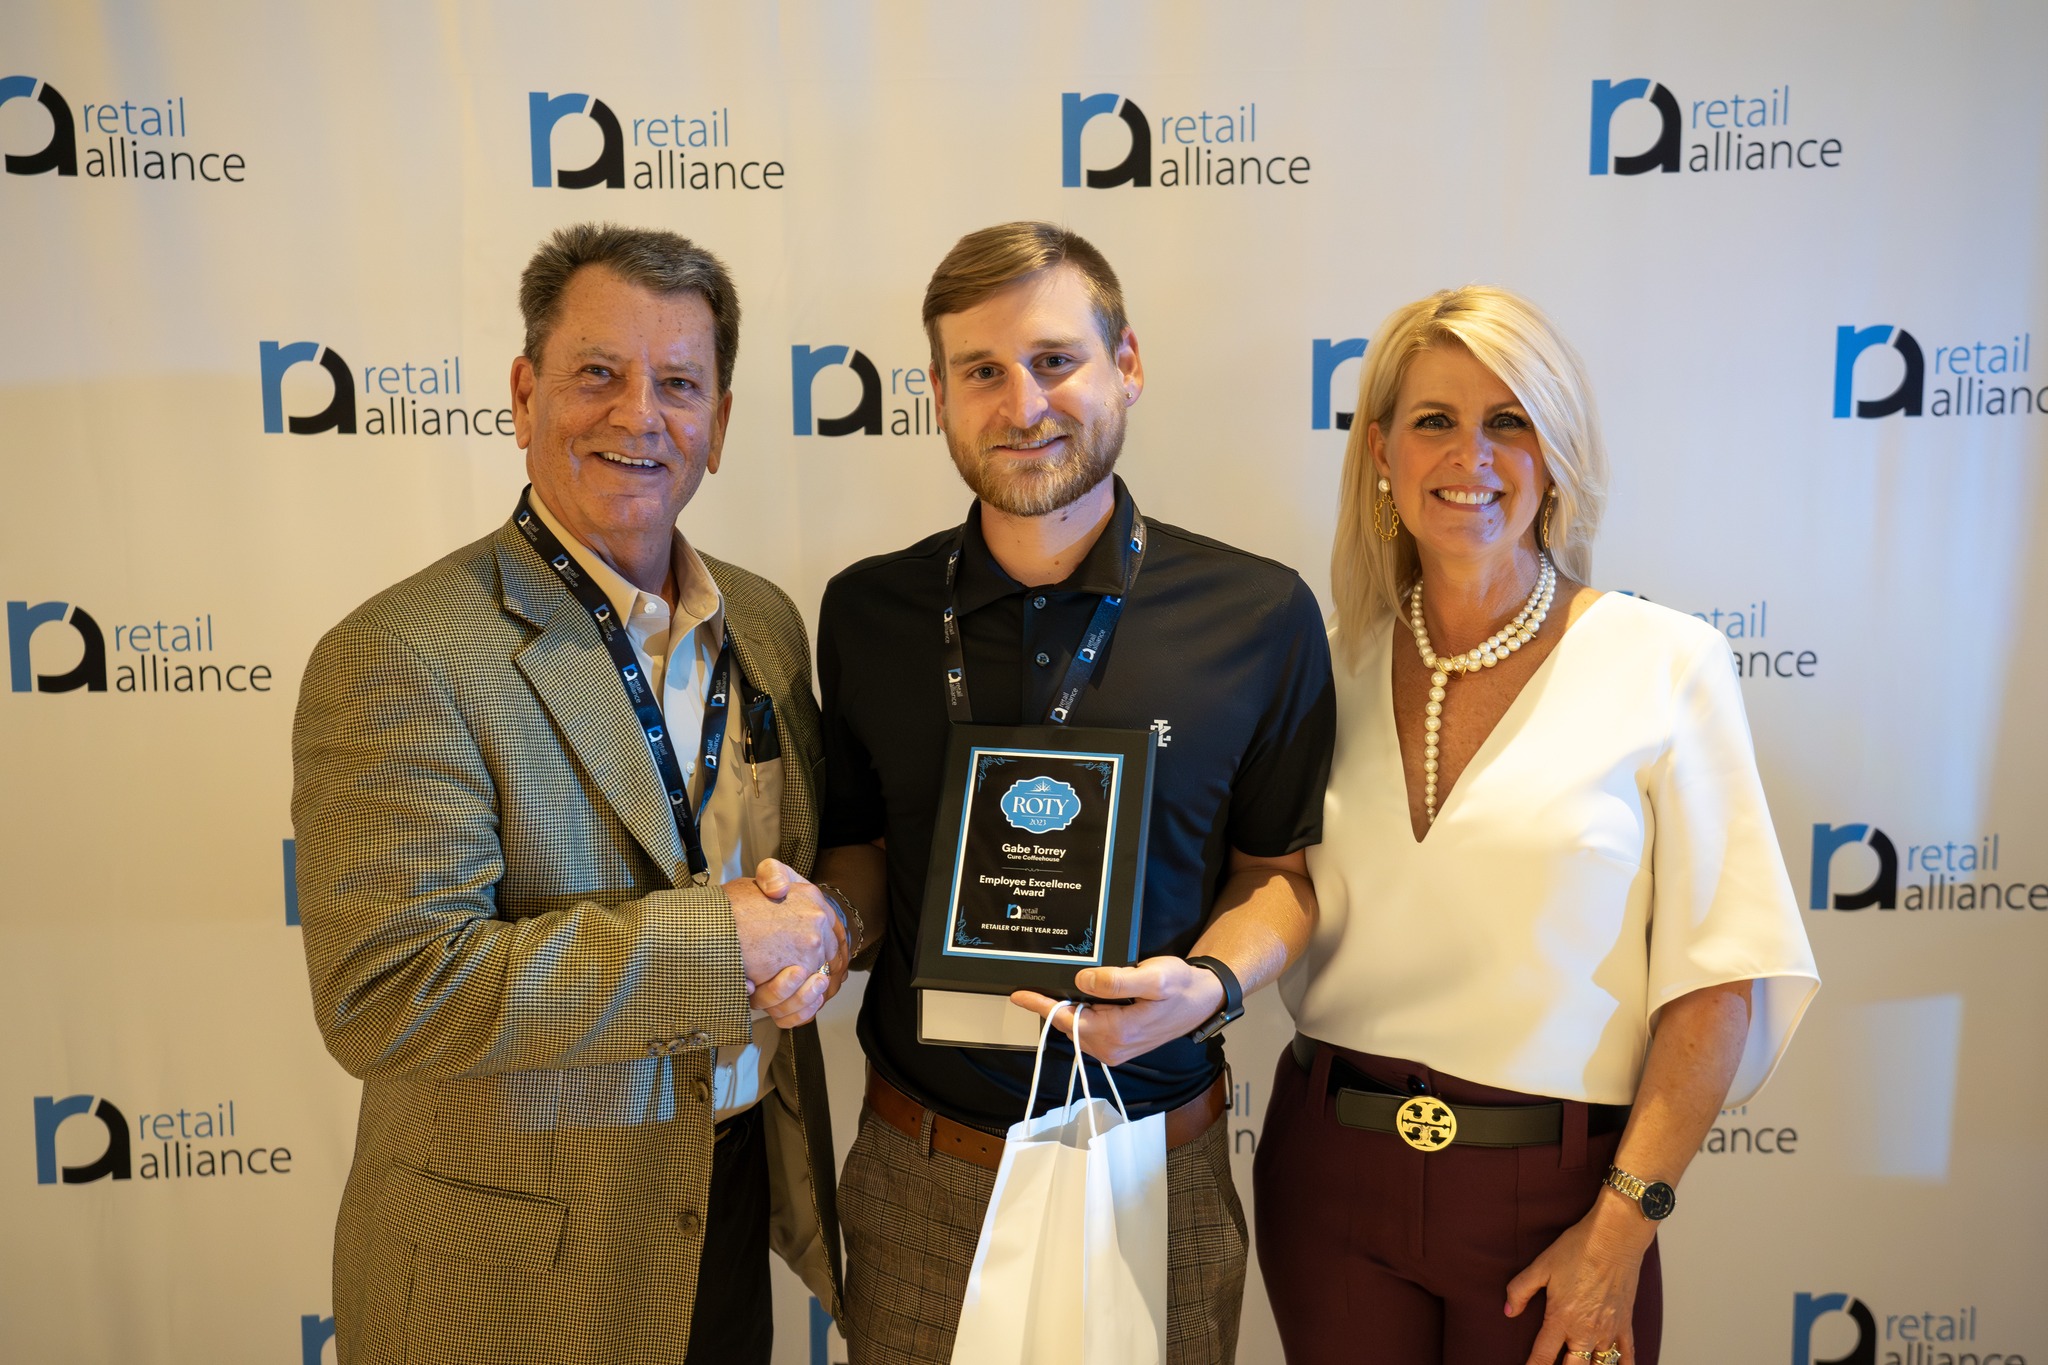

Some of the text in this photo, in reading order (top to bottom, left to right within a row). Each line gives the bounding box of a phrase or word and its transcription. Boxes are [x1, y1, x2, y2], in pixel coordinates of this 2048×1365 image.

[84, 97, 185, 137] retail
[1162, 103, 1255, 144] retail
[1693, 85, 1789, 128] retail
[634, 108, 728, 147] retail
[86, 137, 245, 182] alliance
[634, 150, 784, 189] alliance
[1160, 147, 1310, 187] alliance
[1689, 131, 1842, 172] alliance
[1936, 333, 2030, 374] retail
[365, 357, 460, 394] retail
[1932, 377, 2048, 417] allianc
[366, 398, 515, 436] alliance
[115, 614, 212, 652] retail
[1087, 633, 1096, 648] retail
[1093, 629, 1106, 651] alliance
[116, 655, 271, 692] alliance
[627, 680, 641, 704] alliance
[633, 678, 645, 694] retail
[1059, 691, 1070, 707] retail
[1065, 687, 1078, 711] alliance
[651, 741, 663, 765] alliance
[658, 740, 668, 756] retail
[1012, 796, 1069, 815] ROTY
[1029, 818, 1047, 826] 2023
[1002, 843, 1066, 858] Gabe Torrey
[1907, 833, 1999, 872] retail
[980, 875, 1082, 889] Employee Excellence
[1013, 887, 1045, 897] Award
[1904, 874, 2048, 911] alliance
[140, 1100, 234, 1139] retail
[1707, 1127, 1798, 1154] ance
[140, 1141, 291, 1179] alliance
[1886, 1306, 1976, 1342] retail
